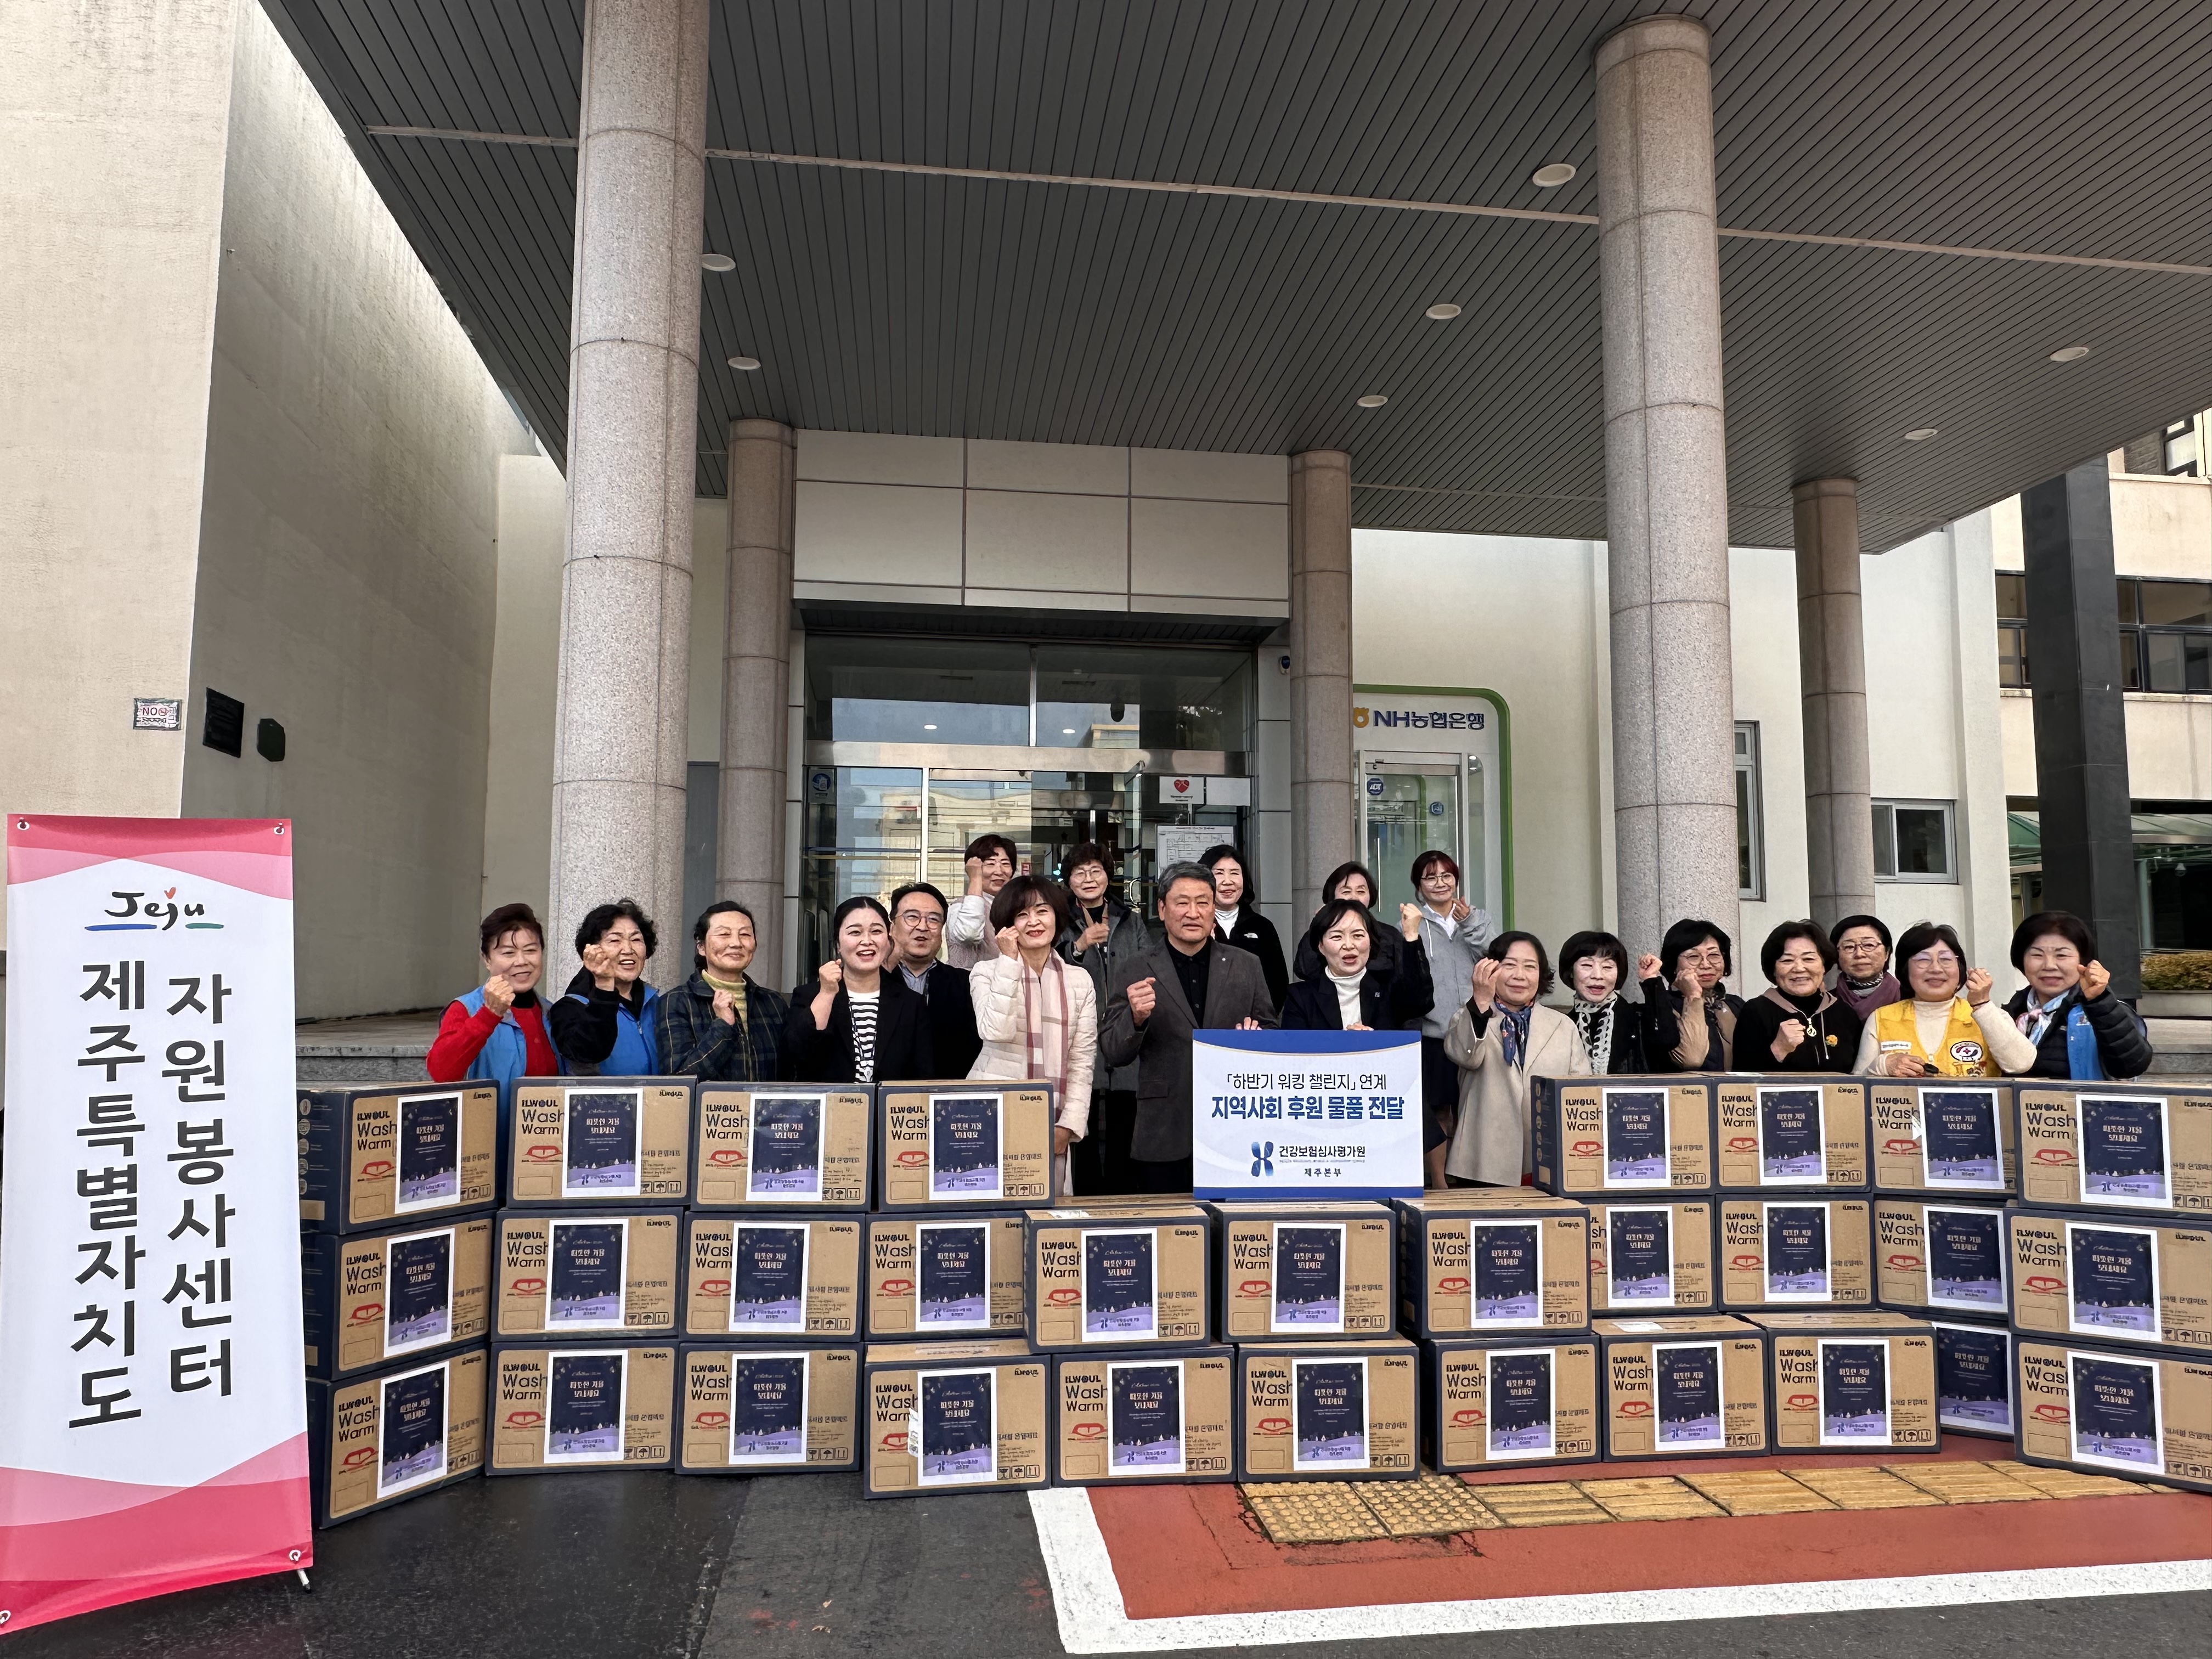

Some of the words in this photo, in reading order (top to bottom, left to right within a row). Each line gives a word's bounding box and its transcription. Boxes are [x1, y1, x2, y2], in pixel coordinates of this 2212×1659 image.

[143, 707, 157, 715] NO
[1374, 710, 1485, 730] NH농협은행
[104, 887, 206, 930] Jeju
[1278, 1074, 1305, 1090] 워킹
[1359, 1074, 1386, 1090] 연계
[1212, 1096, 1282, 1119] 지역사회
[1288, 1096, 1323, 1120] 후원
[1328, 1096, 1363, 1119] 물품
[1369, 1096, 1404, 1120] 전달
[1566, 1107, 1602, 1120] Wash
[706, 1114, 749, 1128] Wash
[1723, 1118, 1755, 1127] Warm
[2027, 1113, 2076, 1126] Wash
[357, 1122, 397, 1136] Wash
[522, 1124, 559, 1135] Warm
[1567, 1121, 1599, 1131] Warm
[706, 1128, 742, 1140] Warm
[891, 1130, 927, 1141] Warm
[2029, 1126, 2069, 1139] Warm
[357, 1139, 391, 1150] Warm
[1279, 1146, 1365, 1157] 건강보험심사평가원
[162, 974, 236, 1397] 자원봉사센터
[69, 960, 146, 1429] 제주특별자치도
[1726, 1222, 1763, 1234] Wash
[1880, 1221, 1923, 1234] Wash
[1727, 1235, 1759, 1244] Warm
[1881, 1234, 1918, 1246] Warm
[876, 1244, 916, 1257] Wash
[2017, 1239, 2066, 1255] Wash
[507, 1256, 545, 1267] Warm
[696, 1258, 732, 1268] Warm
[876, 1259, 911, 1269] Warm
[1234, 1259, 1269, 1269] Warm
[1433, 1256, 1468, 1267] Warm
[2019, 1253, 2061, 1267] Warm
[1042, 1267, 1079, 1278] Warm
[347, 1280, 382, 1295] Warm
[504, 1374, 547, 1387] Wash
[1446, 1373, 1486, 1387] Wash
[1781, 1373, 1816, 1384] Warm
[1614, 1380, 1649, 1391] Warm
[2027, 1380, 2068, 1396] Warm
[504, 1389, 541, 1400] Warm
[691, 1390, 728, 1400] Warm
[1447, 1388, 1481, 1400] Warm
[1066, 1400, 1103, 1412] Warm
[1252, 1396, 1289, 1407] Warm
[339, 1425, 374, 1442] Warm
